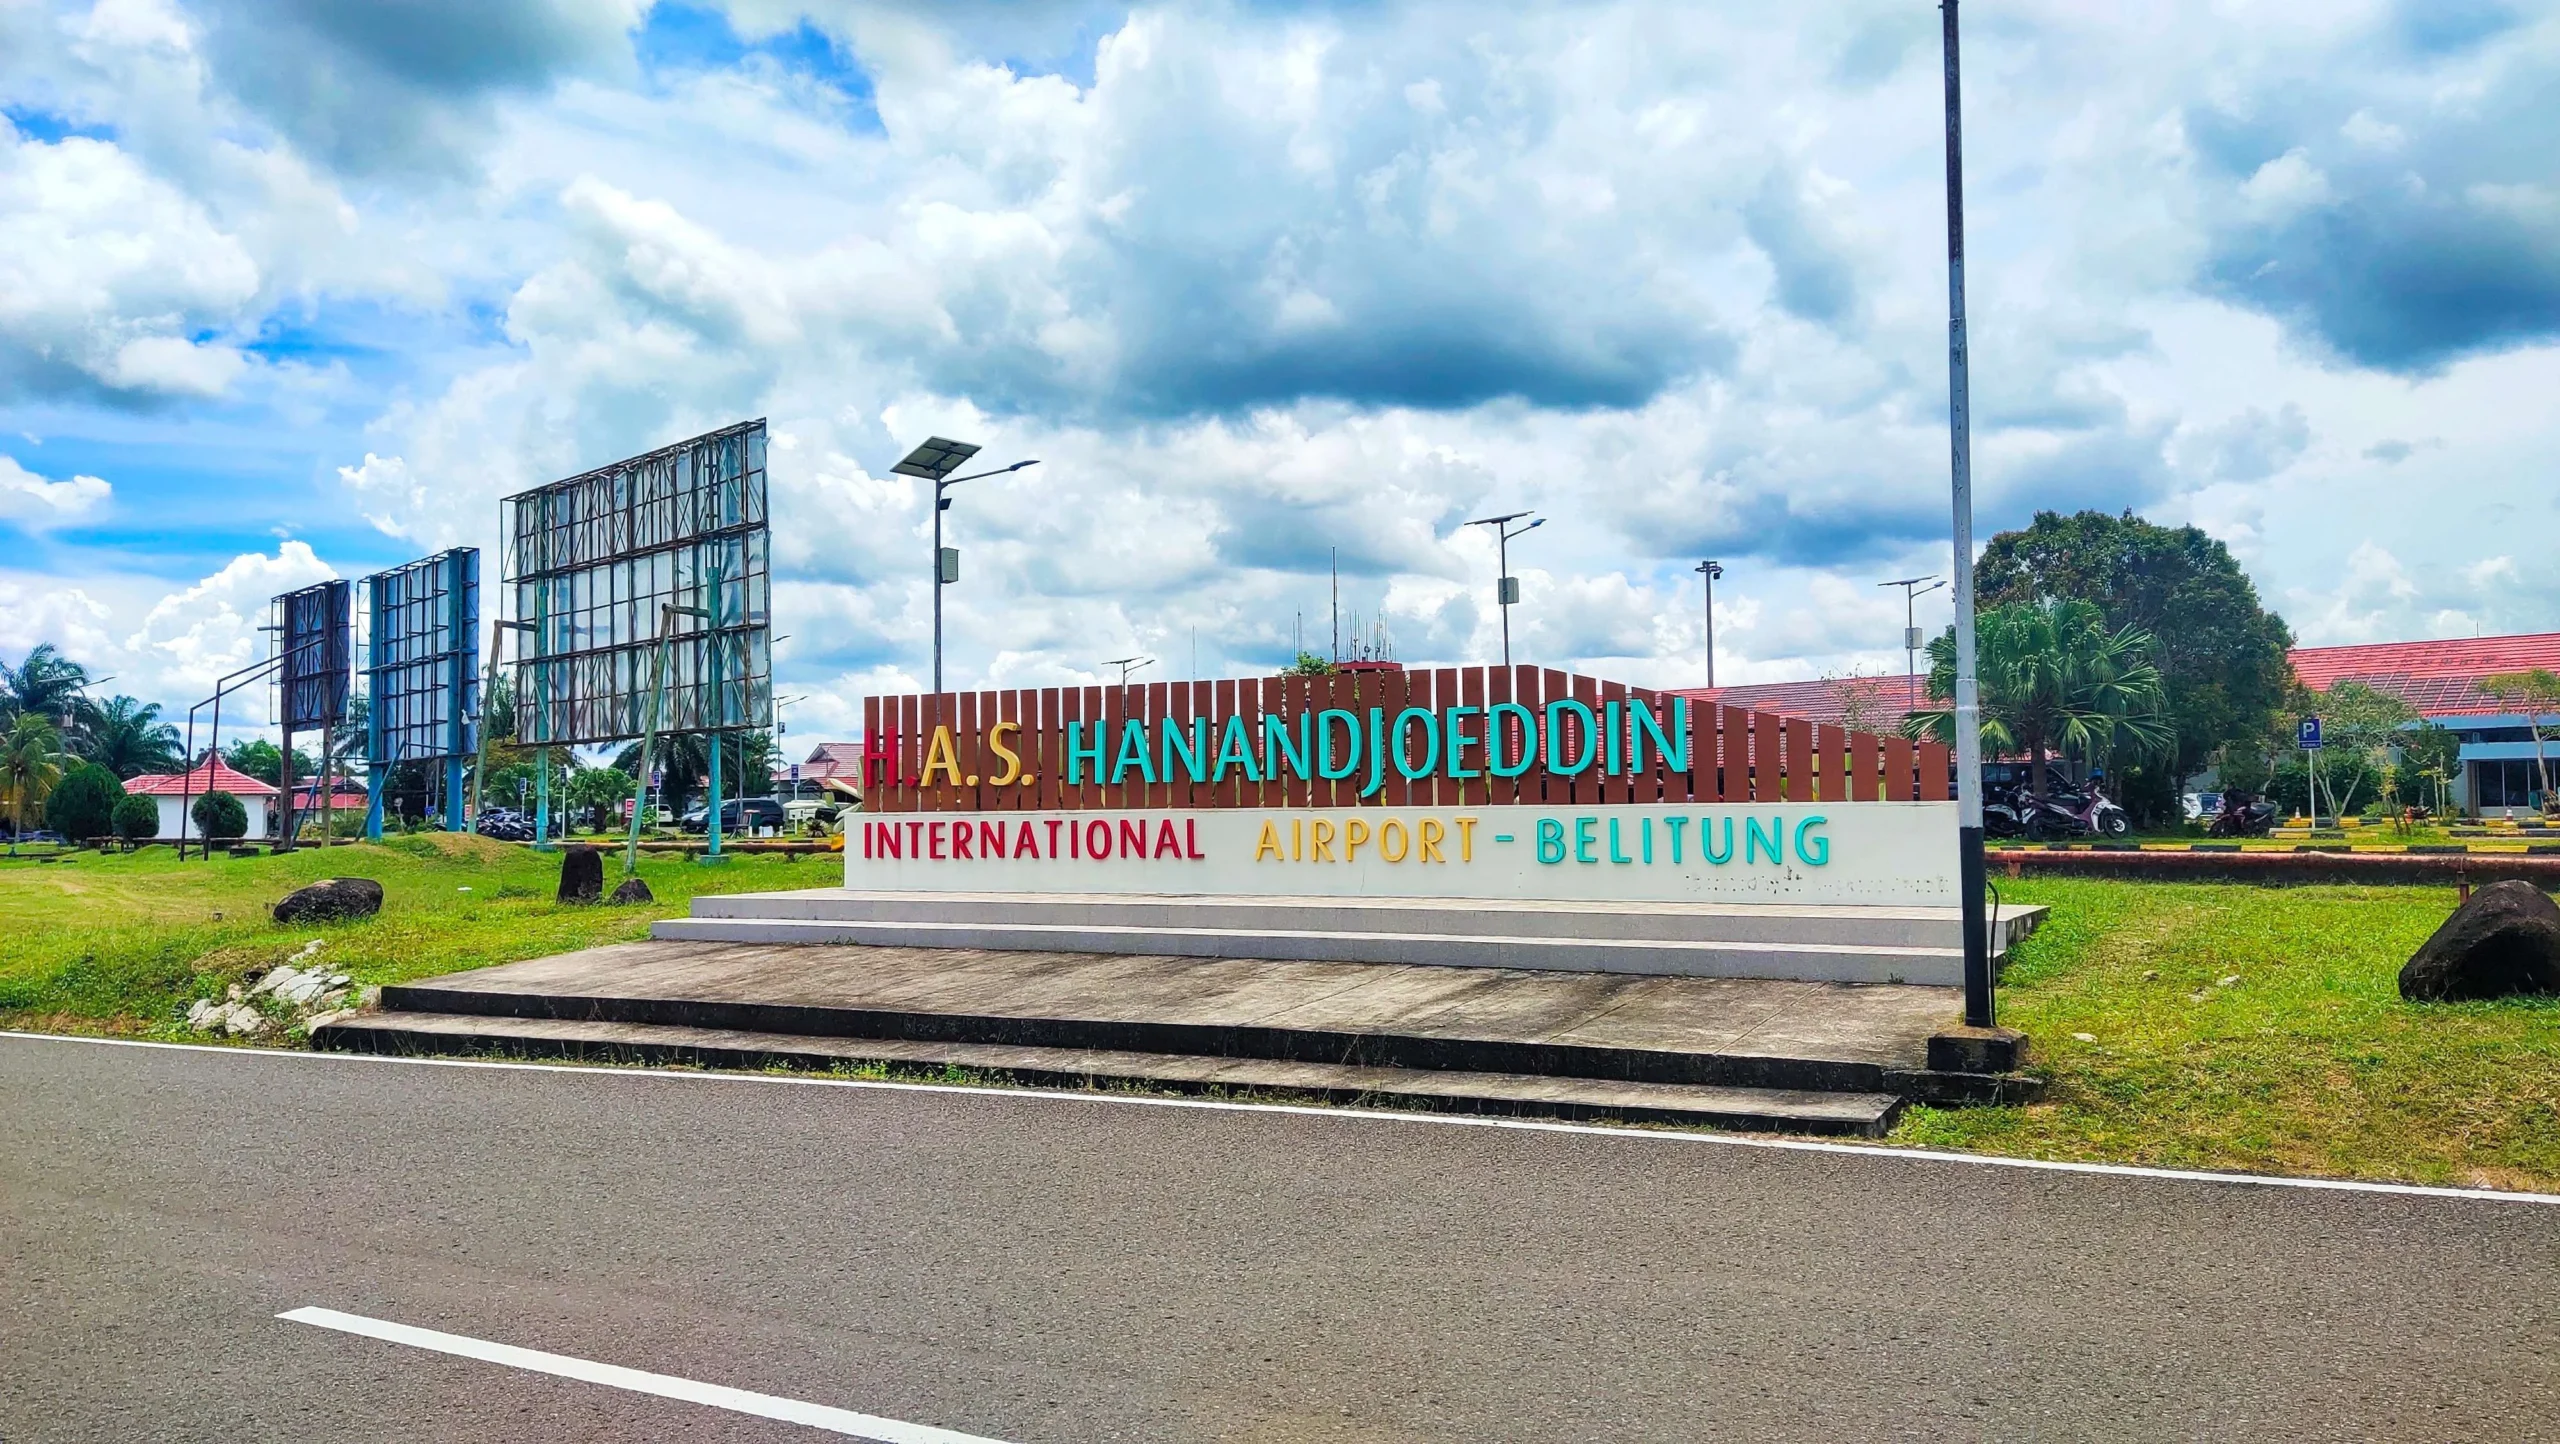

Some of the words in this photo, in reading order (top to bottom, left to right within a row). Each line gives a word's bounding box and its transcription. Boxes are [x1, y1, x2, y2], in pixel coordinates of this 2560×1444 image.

[864, 721, 1034, 788] H.A.S.
[1068, 697, 1687, 798] HANANDJOEDDIN
[2303, 722, 2315, 738] P
[864, 818, 1204, 860] INTERNATIONAL
[1256, 817, 1478, 863] AIRPORT
[1536, 816, 1829, 866] BELITUNG
